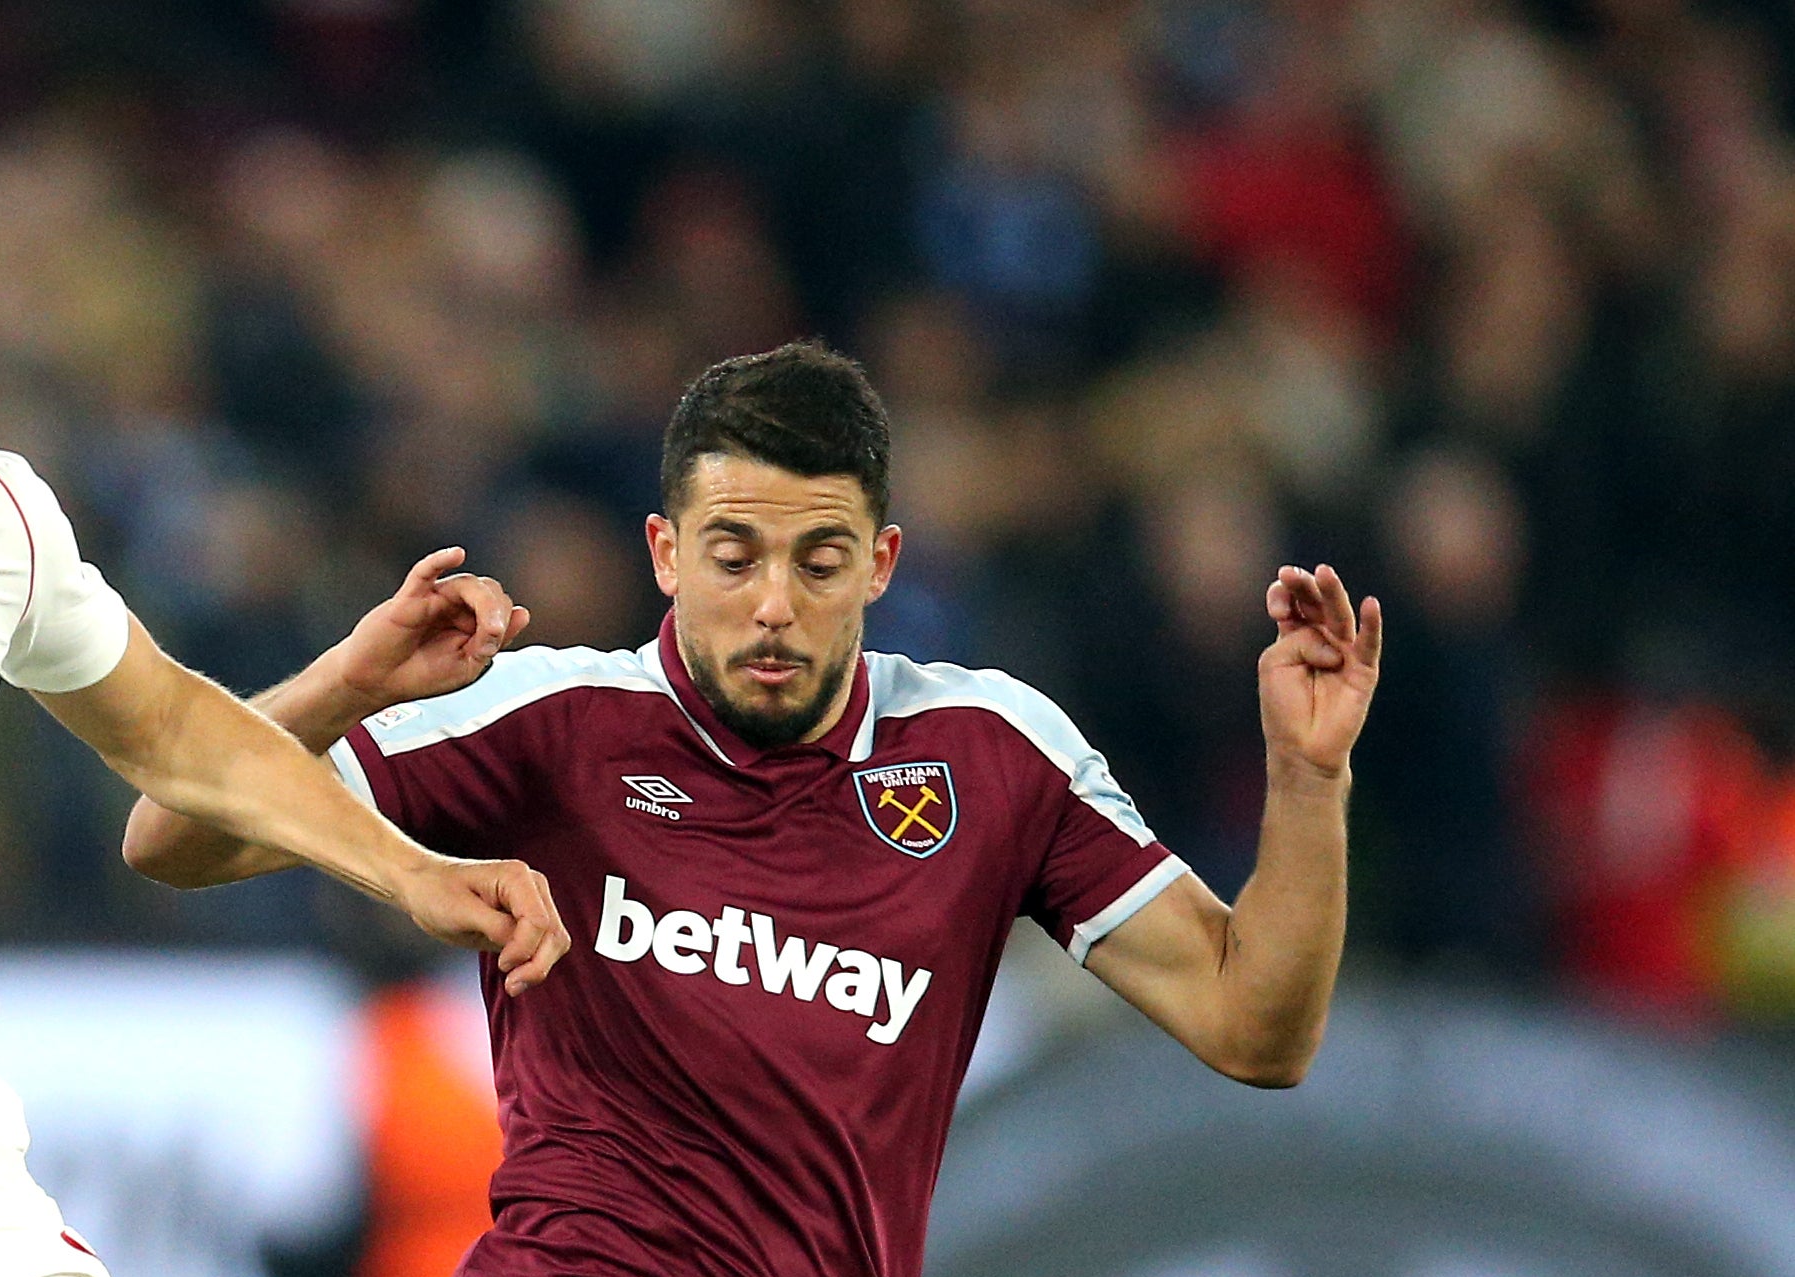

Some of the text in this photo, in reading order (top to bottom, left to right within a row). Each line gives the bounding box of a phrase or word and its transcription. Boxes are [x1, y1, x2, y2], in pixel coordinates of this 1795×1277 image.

[864, 766, 941, 784] WEST HAM
[881, 775, 927, 788] UNITED
[625, 796, 680, 821] umbro
[901, 838, 935, 848] LONDON
[594, 874, 933, 1045] betway
